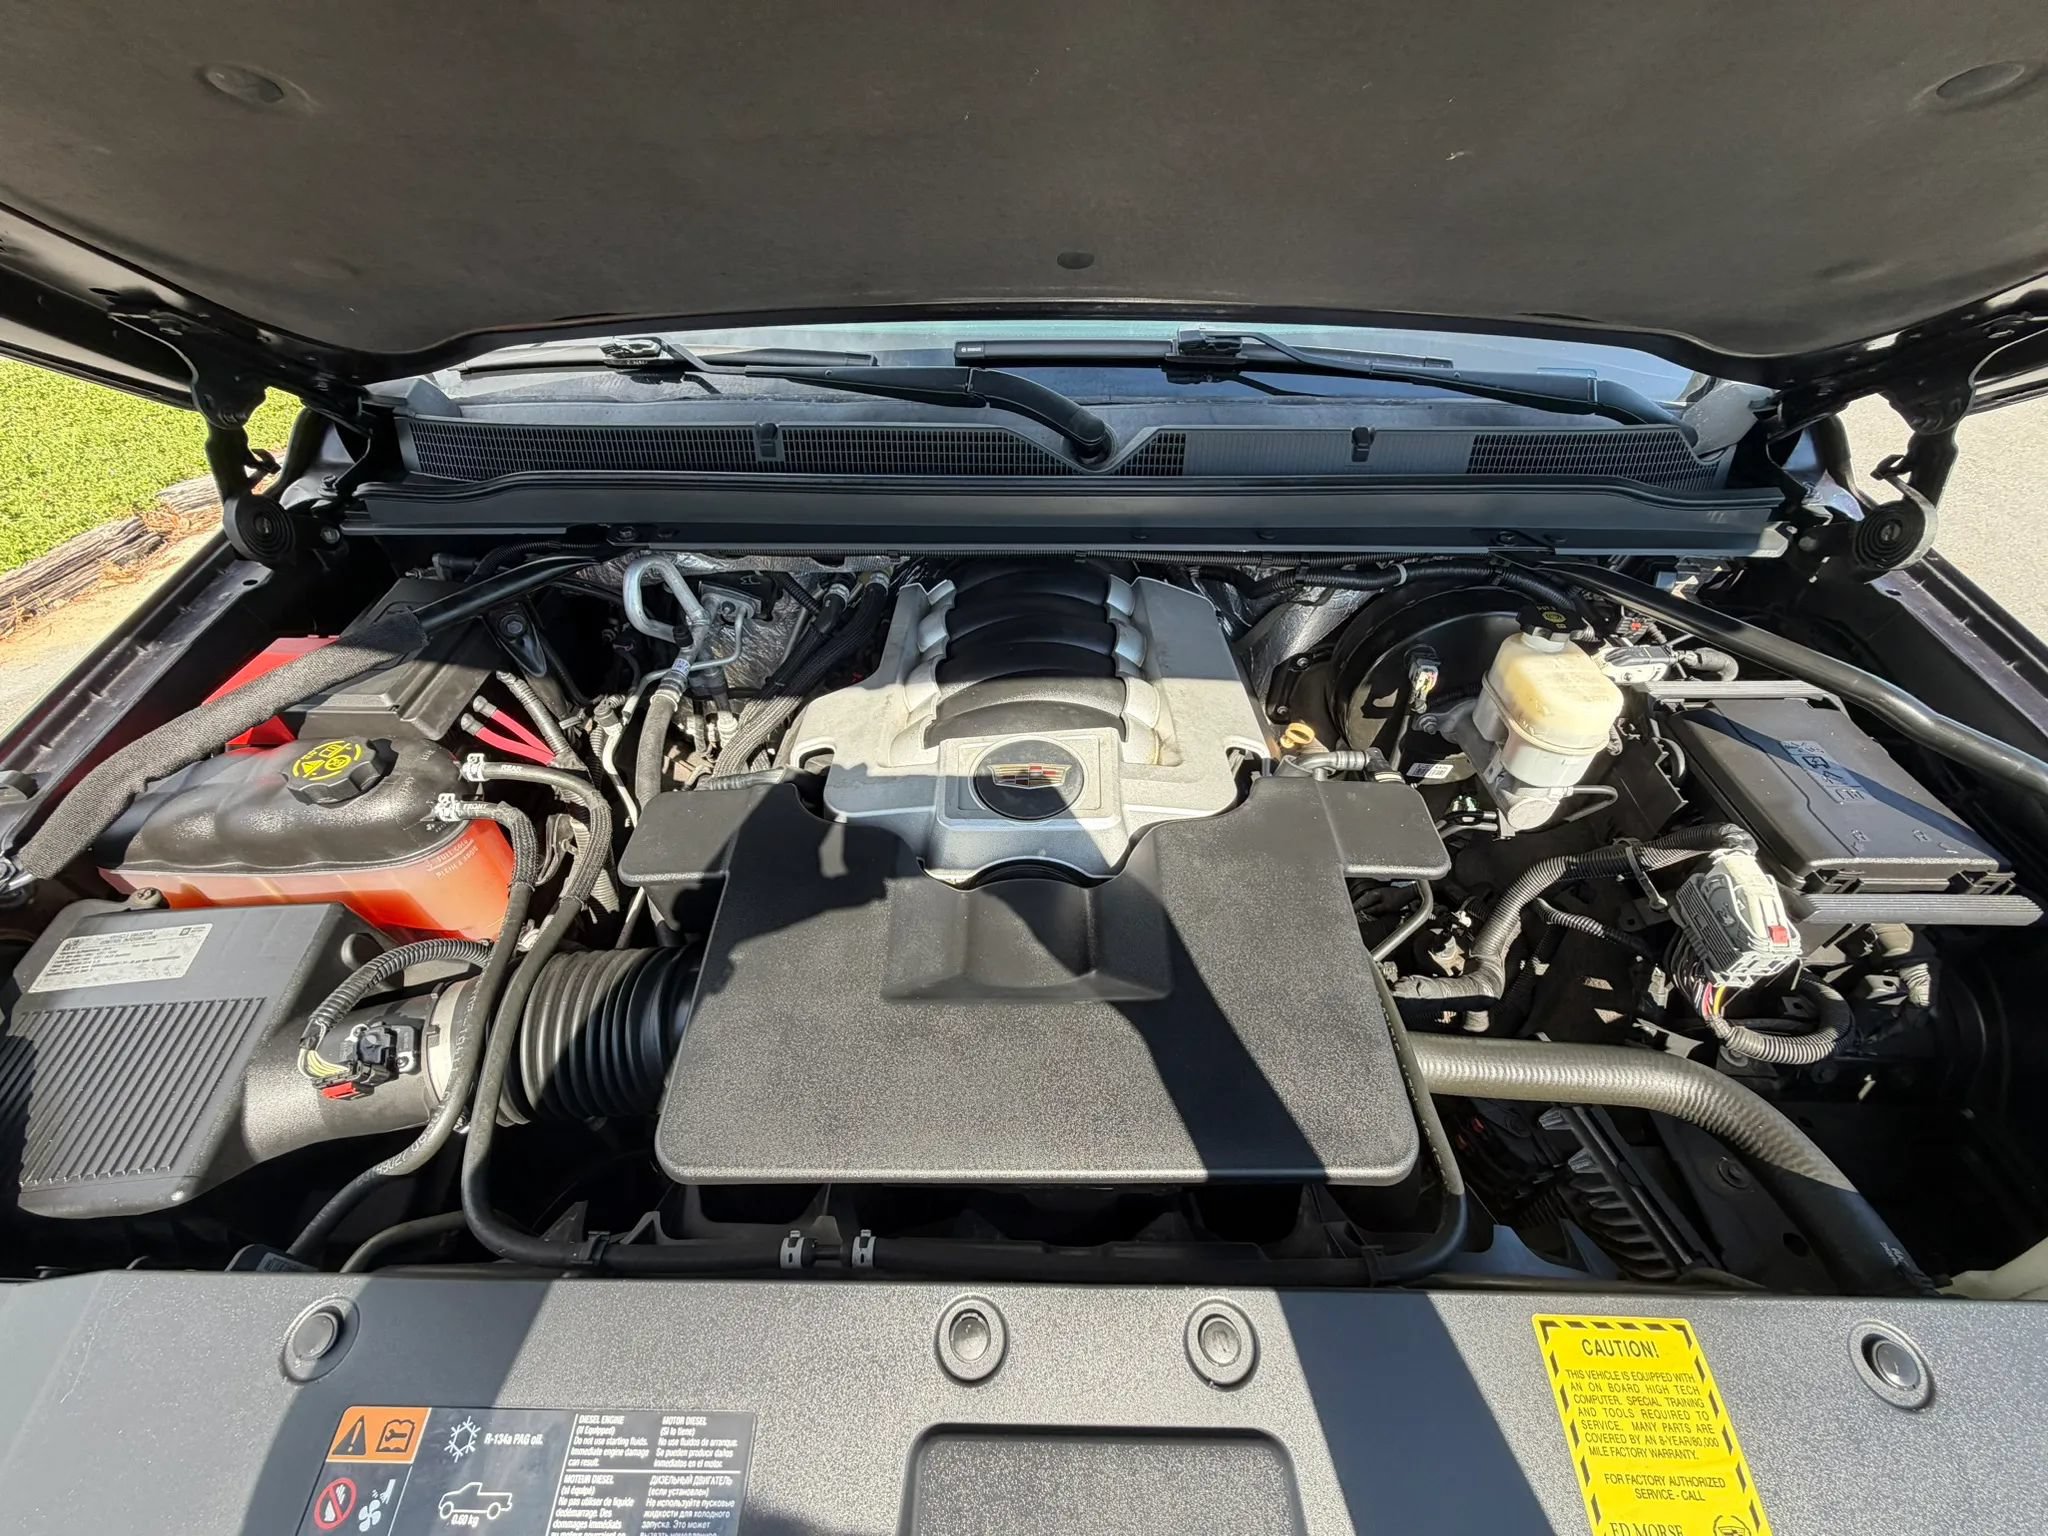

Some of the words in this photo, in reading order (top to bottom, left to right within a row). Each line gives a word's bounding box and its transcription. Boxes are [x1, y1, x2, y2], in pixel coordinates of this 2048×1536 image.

[462, 803, 488, 811] FRONT
[1582, 1338, 1660, 1358] CAUTION!
[1565, 1369, 1585, 1379] THIS
[1585, 1370, 1621, 1380] VEHICLE
[1621, 1371, 1630, 1381] IS
[1631, 1371, 1673, 1382] EQUIPPED
[1673, 1373, 1696, 1383] WITH
[1571, 1382, 1583, 1392] AN
[1588, 1382, 1603, 1392] ON
[1607, 1383, 1640, 1393] BOARD
[1645, 1384, 1670, 1395] HIGH
[1674, 1385, 1700, 1395] TECH
[1626, 1396, 1662, 1407] SPECIAL
[1664, 1397, 1705, 1408] TRAINING
[1578, 1407, 1597, 1417] AND
[1602, 1408, 1635, 1418] TOOLS
[1640, 1409, 1691, 1420] REQUIRED
[1695, 1410, 1710, 1421] TO
[579, 1415, 600, 1424] DIESEL
[601, 1415, 625, 1425] ENGINE
[662, 1416, 686, 1425] MOTOR
[685, 1416, 707, 1426] DIESEL
[584, 1426, 615, 1436] Equipped)
[660, 1427, 669, 1436] (Si
[677, 1427, 696, 1437] tiene)
[1581, 1420, 1624, 1431] SERVICE.
[1631, 1422, 1657, 1432] MANY
[1661, 1422, 1692, 1433] PARTS
[1696, 1424, 1715, 1434] ARE
[484, 1433, 512, 1445] R-134a
[513, 1433, 531, 1445] PAG
[573, 1436, 582, 1445] Do
[583, 1437, 594, 1445] not
[606, 1437, 629, 1447] starting
[630, 1437, 648, 1446] fluids.
[658, 1437, 667, 1446] No
[668, 1438, 679, 1446] use
[680, 1437, 700, 1446] fluidos
[701, 1438, 709, 1446] de
[710, 1439, 738, 1448] arranque.
[1585, 1432, 1627, 1443] COVERED
[1628, 1434, 1641, 1445] BY
[1645, 1435, 1657, 1445] AN
[1659, 1435, 1720, 1448] 8-YEAR/80,000
[571, 1447, 603, 1456] Immediate
[603, 1447, 624, 1458] engine
[625, 1447, 649, 1458] damage
[656, 1447, 665, 1457] Se
[665, 1448, 688, 1458] pueden
[688, 1448, 714, 1458] producir
[1588, 1446, 1609, 1456] MILE
[1609, 1446, 1648, 1458] FACTORY
[1648, 1448, 1700, 1460] WARRANTY.
[568, 1458, 580, 1466] can
[580, 1458, 600, 1467] result.
[688, 1460, 696, 1468] en
[697, 1459, 704, 1468] el
[704, 1460, 723, 1468] motor.
[564, 1474, 591, 1484] MOTEUR
[591, 1475, 614, 1485] DIESEL
[649, 1474, 693, 1486] ДИЗЕЛЬНЫЙ
[692, 1475, 733, 1486] ДВИГАТЕЛЬ
[1604, 1473, 1625, 1484] FOR
[1625, 1474, 1666, 1486] FACTORY
[1669, 1476, 1726, 1488] AUTHORIZED
[648, 1487, 667, 1497] (если
[667, 1487, 710, 1497] установлен)
[1635, 1488, 1675, 1500] SERVICE
[1681, 1490, 1706, 1501] CALL
[558, 1496, 568, 1506] Ne
[568, 1498, 580, 1507] pas
[581, 1497, 603, 1506] utiliser
[603, 1497, 612, 1506] de
[613, 1497, 635, 1508] liquide
[646, 1498, 656, 1507] Не
[656, 1498, 700, 1509] используйте
[701, 1500, 736, 1509] пусковые
[599, 1508, 612, 1518] Des
[643, 1510, 678, 1518] жидкости
[678, 1510, 692, 1519] для
[693, 1510, 731, 1519] холодного
[468, 1514, 480, 1528] kg
[552, 1519, 588, 1530] dommages
[672, 1519, 687, 1529] Это
[687, 1521, 711, 1529] может
[1609, 1522, 1631, 1536] ED
[1632, 1523, 1684, 1536] MORSE
